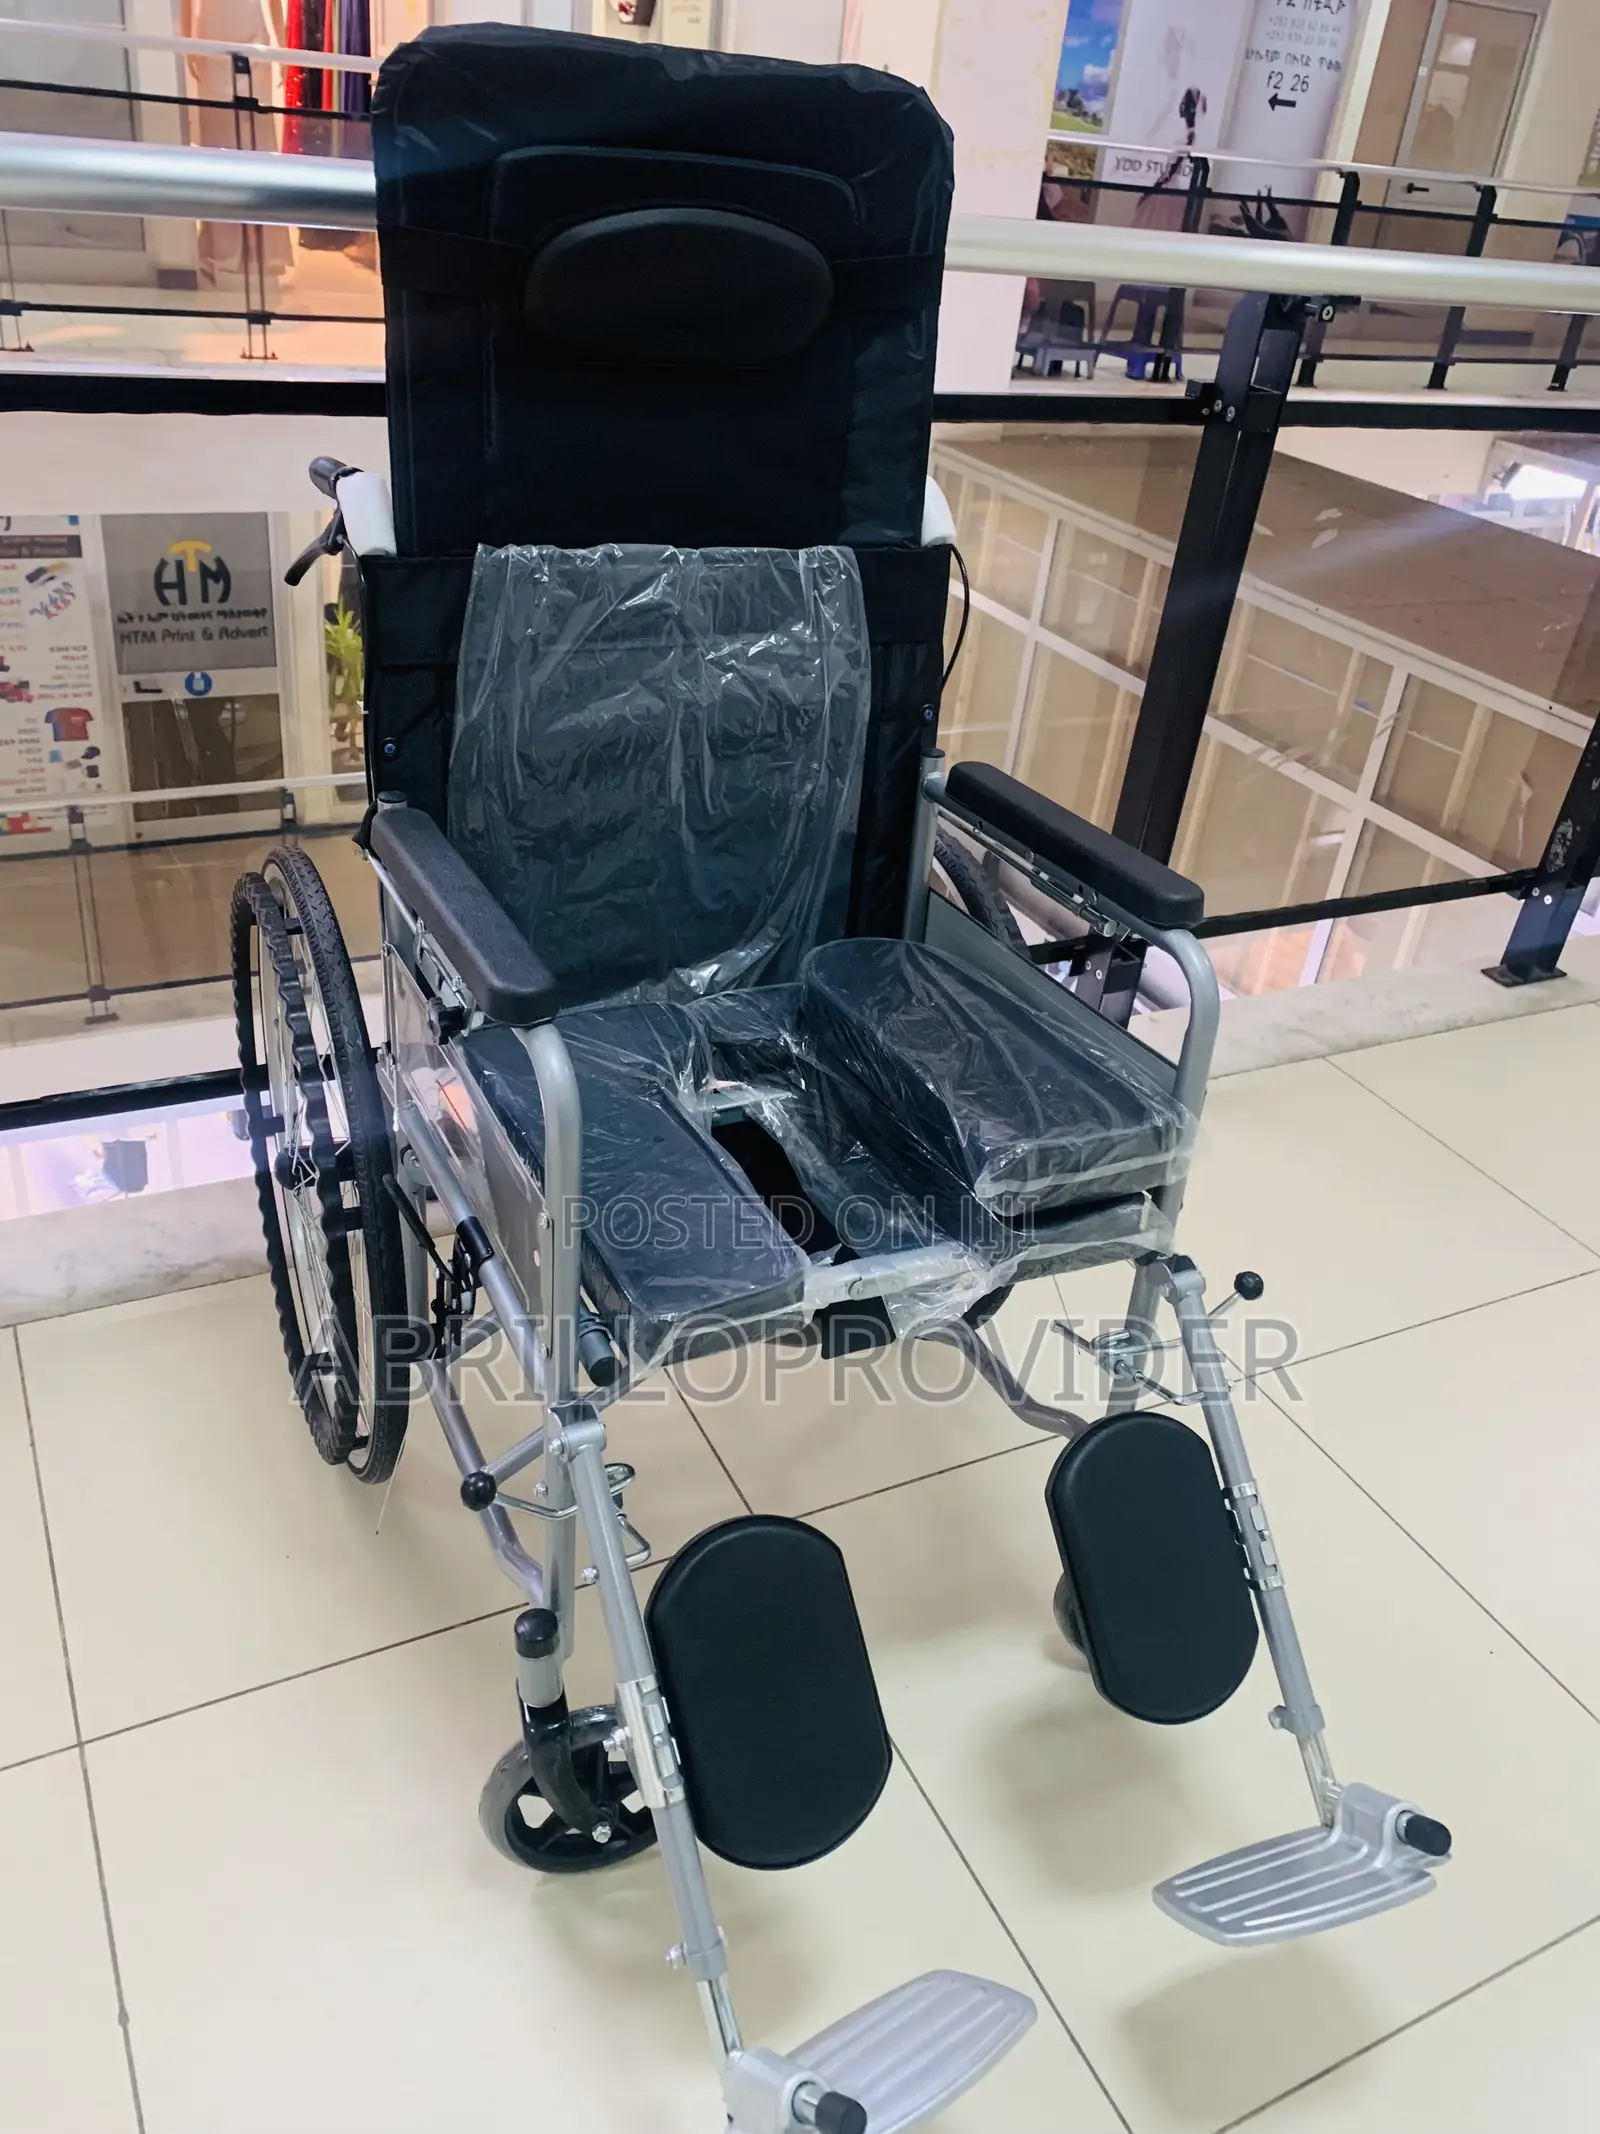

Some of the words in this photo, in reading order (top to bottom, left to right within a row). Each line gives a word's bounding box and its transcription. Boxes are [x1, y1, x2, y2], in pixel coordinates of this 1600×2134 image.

[1290, 74, 1310, 93] 26
[1146, 159, 1193, 177] STUIO
[119, 629, 157, 645] HTM
[162, 627, 196, 643] Print
[219, 625, 269, 640] Advert
